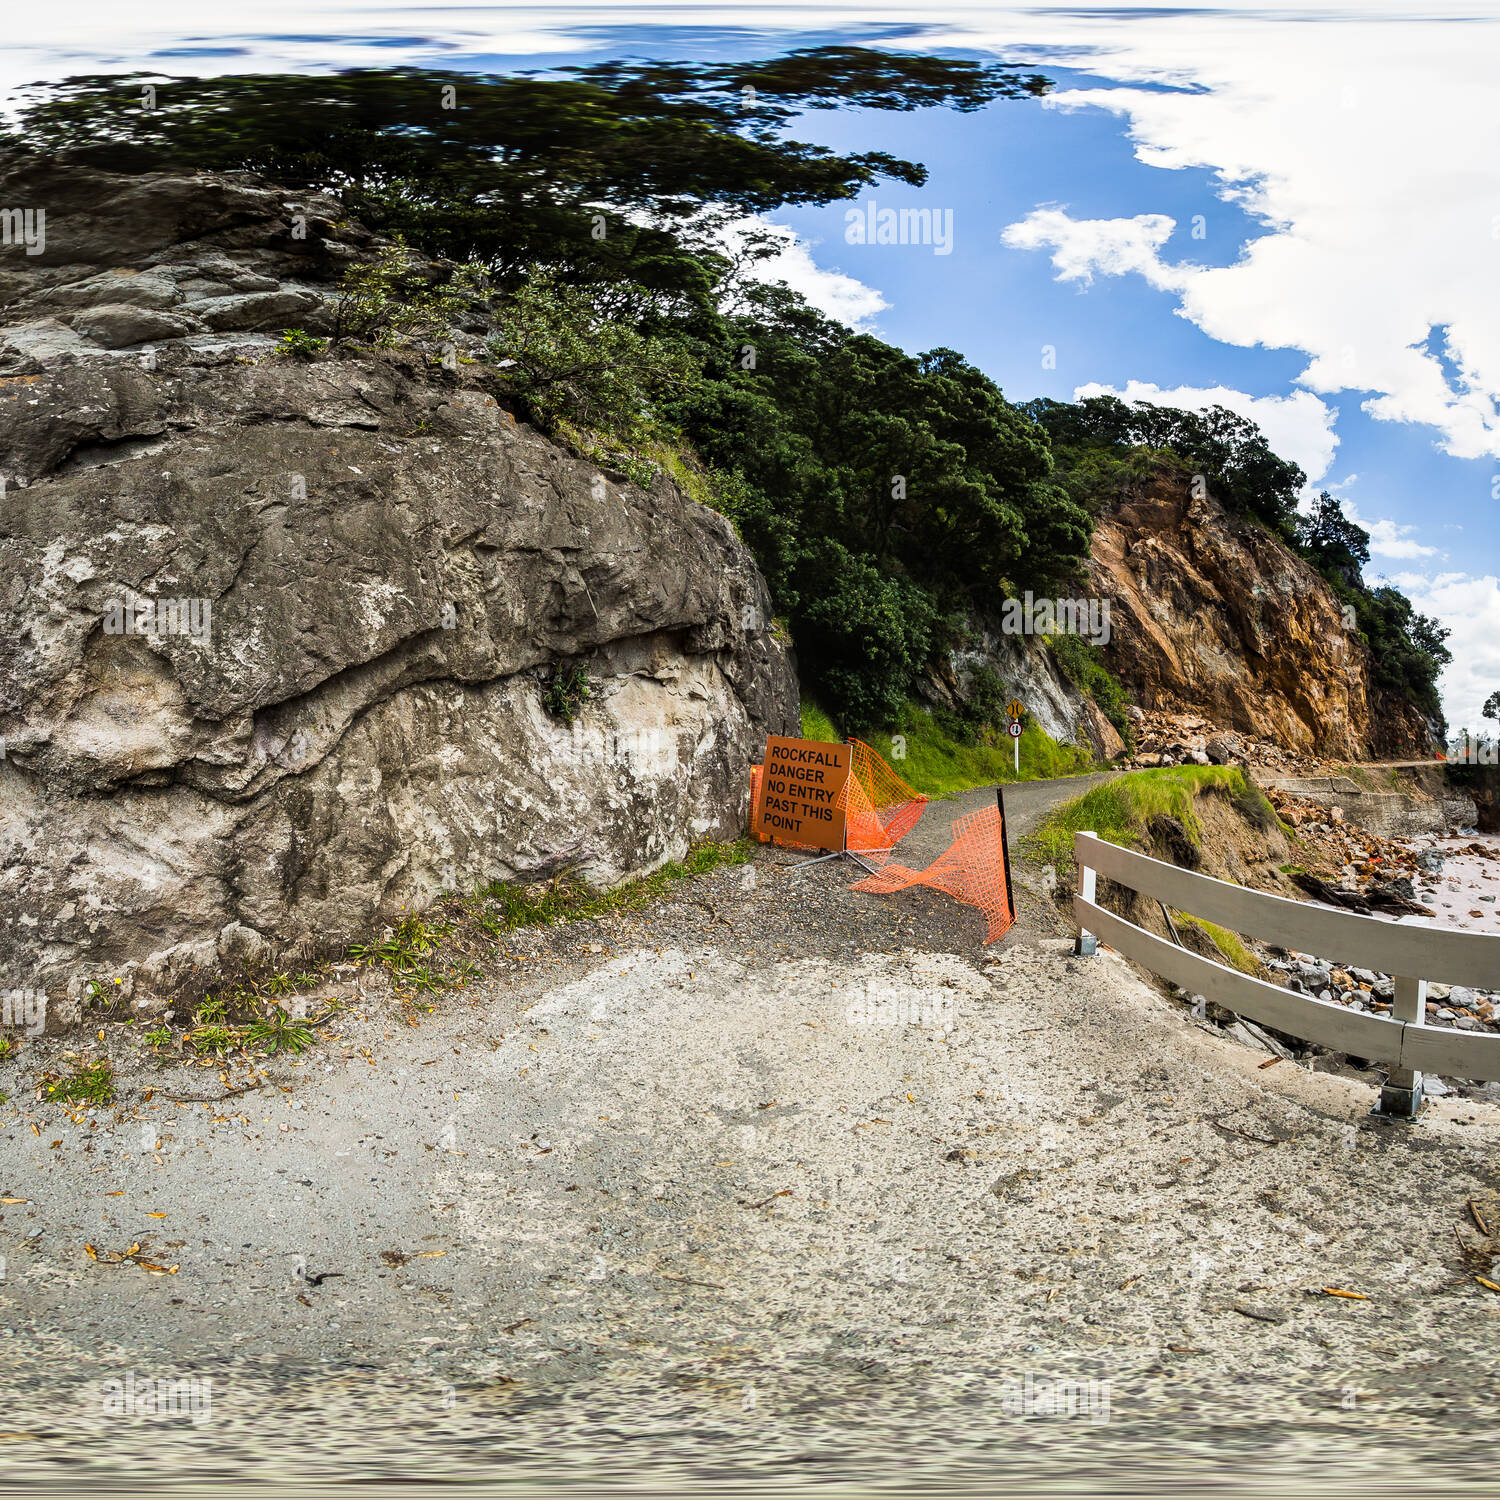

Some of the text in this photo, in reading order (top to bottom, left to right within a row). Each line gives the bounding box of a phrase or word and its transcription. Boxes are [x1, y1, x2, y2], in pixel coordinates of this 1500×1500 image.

[772, 746, 842, 768] ROCKFALL
[769, 763, 824, 783] DANGER
[767, 780, 834, 803] NO ENTRY
[765, 796, 833, 821] PAST THIS
[763, 813, 802, 832] POINT
